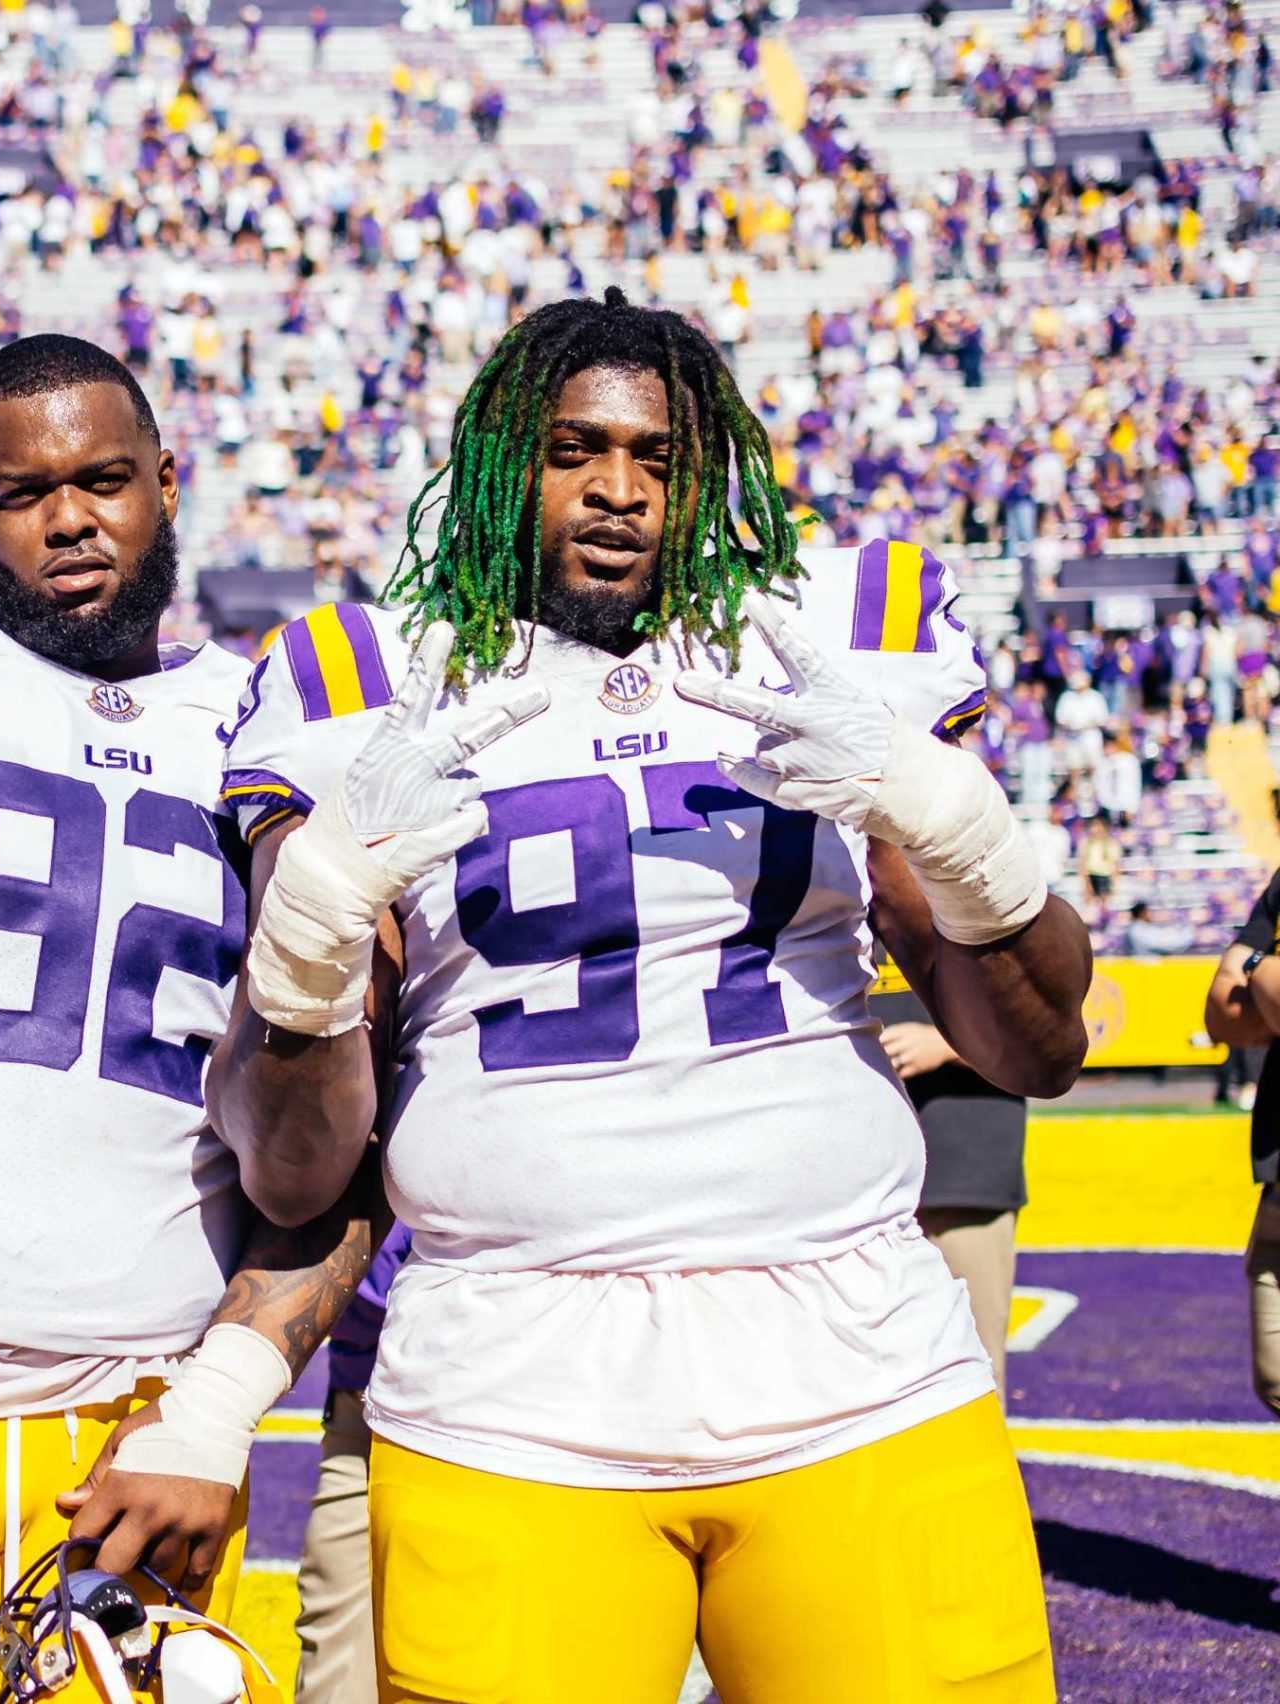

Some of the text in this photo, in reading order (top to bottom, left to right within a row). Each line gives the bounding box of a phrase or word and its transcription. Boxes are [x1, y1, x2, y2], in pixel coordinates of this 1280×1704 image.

[606, 664, 649, 700] SEC
[94, 685, 132, 712] SEC
[84, 744, 152, 775] LSU
[593, 731, 668, 761] LSU
[455, 756, 819, 1072] 97
